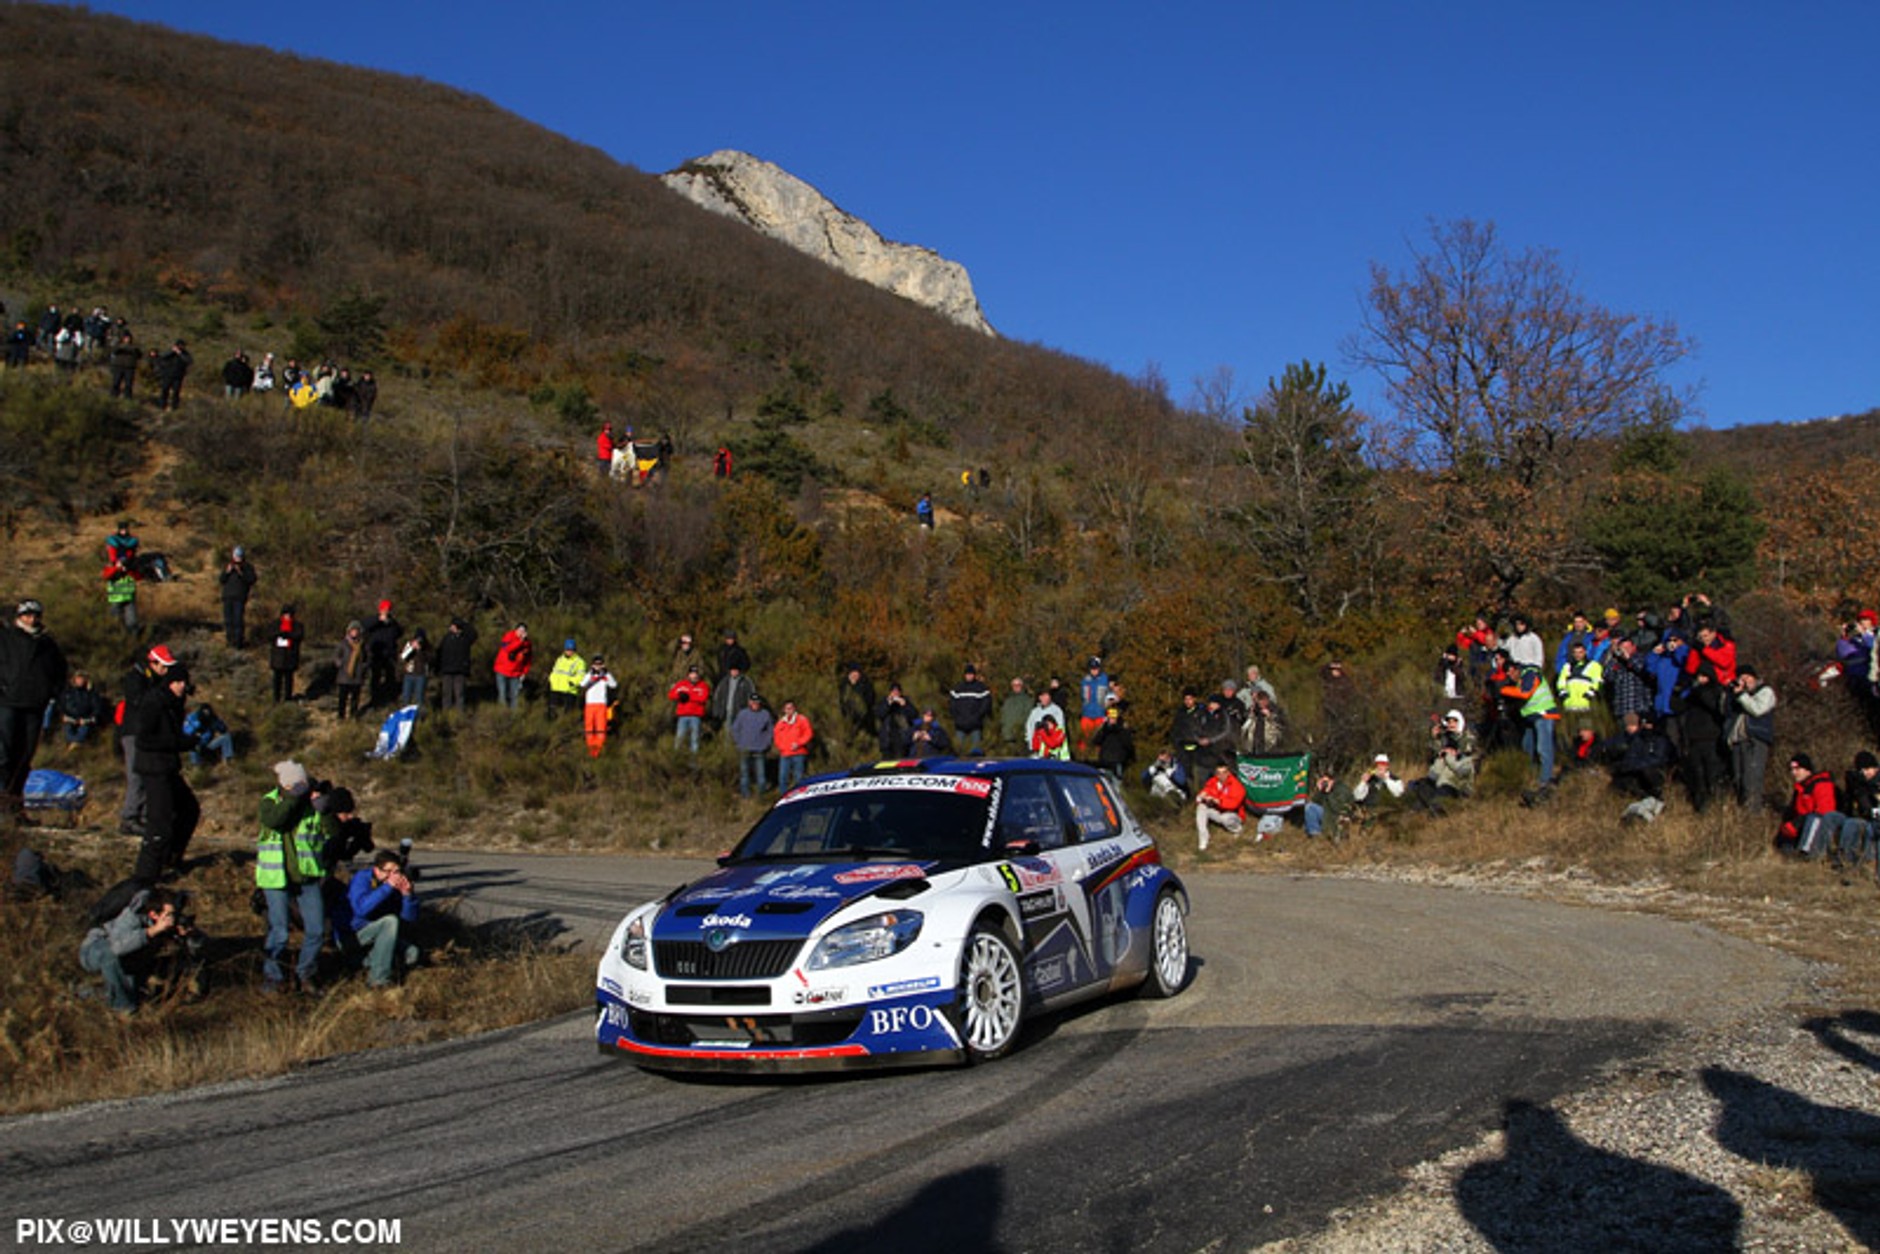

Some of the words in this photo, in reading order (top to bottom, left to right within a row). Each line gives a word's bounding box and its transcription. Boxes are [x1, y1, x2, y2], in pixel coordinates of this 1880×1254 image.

[1094, 782, 1119, 829] 5
[1000, 863, 1020, 894] 5
[607, 1002, 629, 1030] BFO
[871, 1004, 934, 1036] BFO
